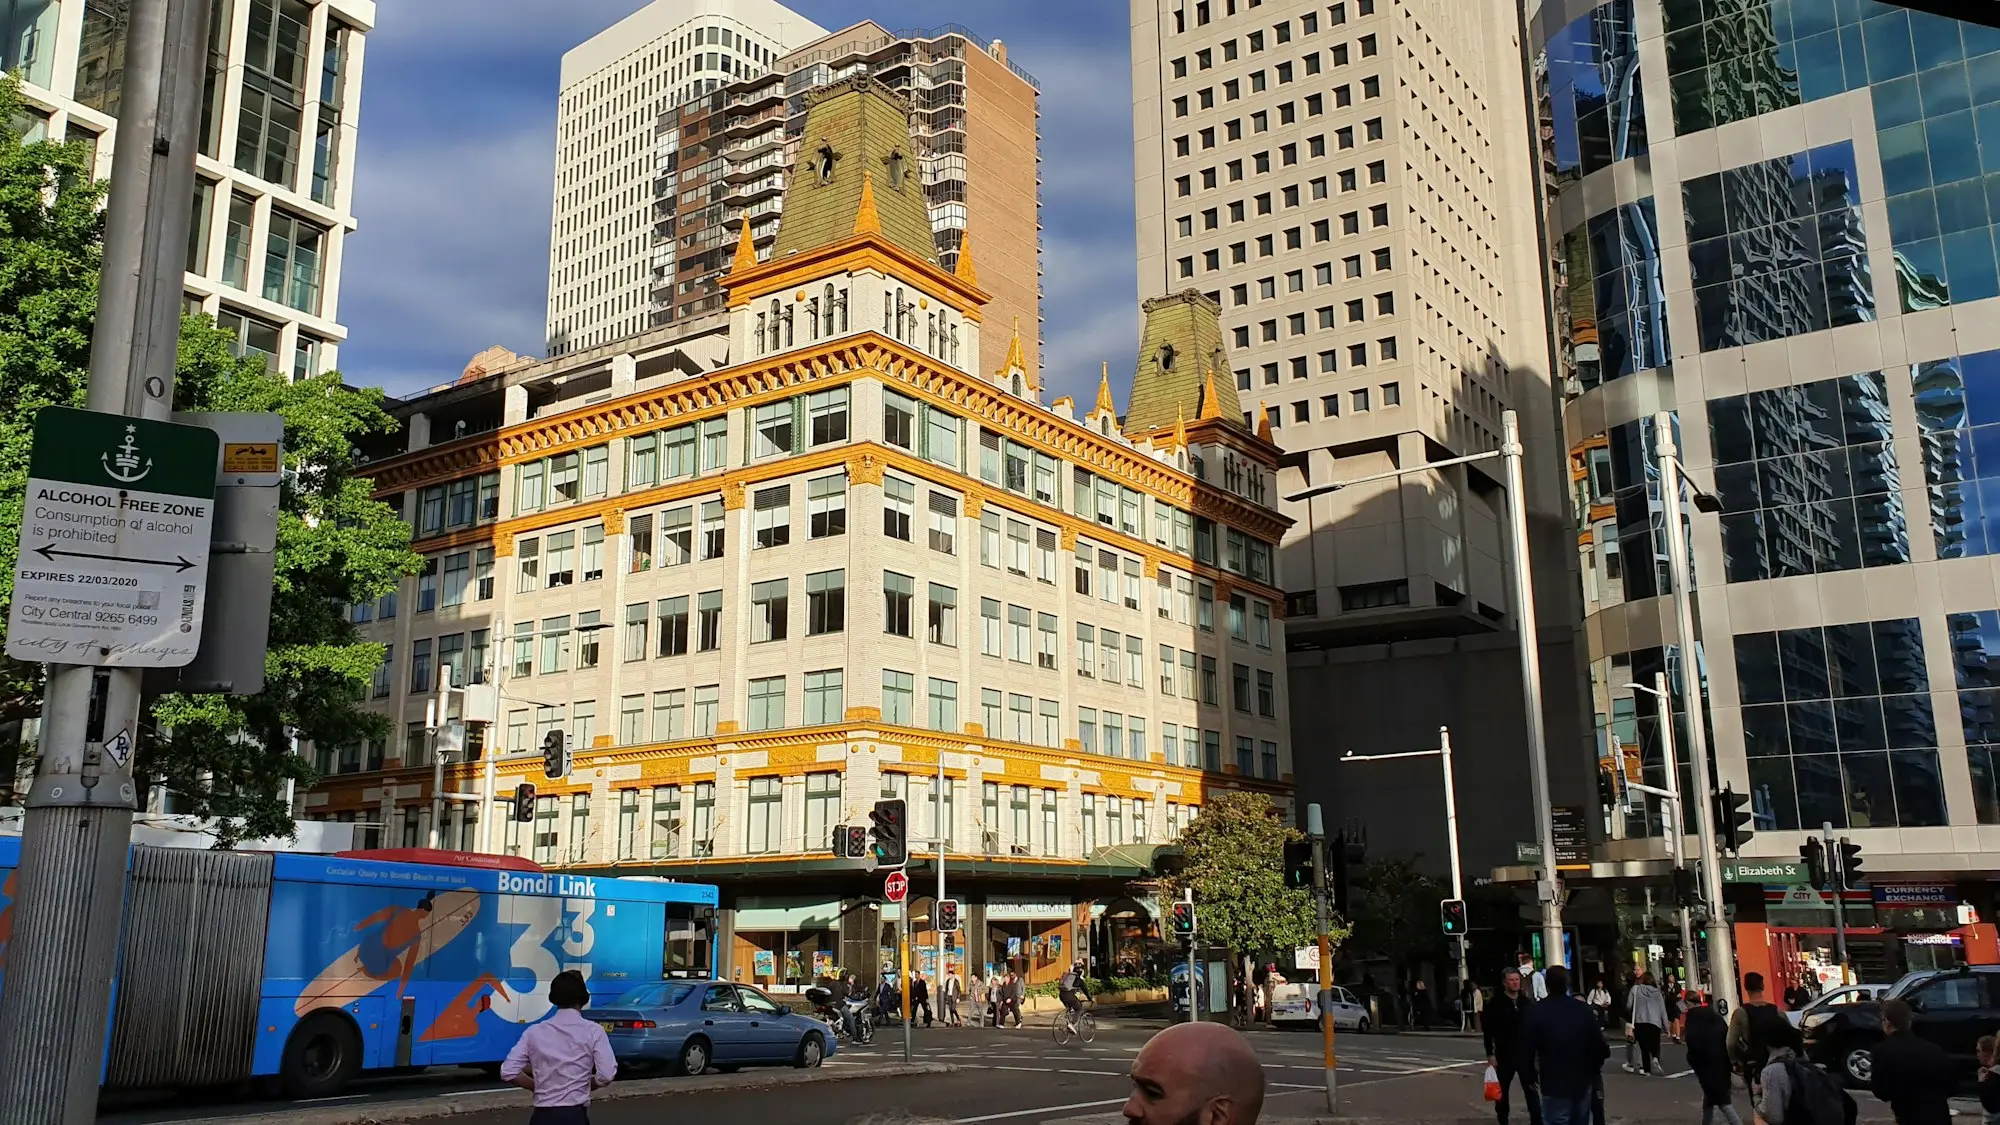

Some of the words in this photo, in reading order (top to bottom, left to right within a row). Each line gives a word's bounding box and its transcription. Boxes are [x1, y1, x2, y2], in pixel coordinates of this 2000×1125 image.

[37, 488, 116, 508] ALCOHOL
[119, 498, 160, 513] FREE
[163, 503, 205, 518] ZONE
[35, 506, 126, 528] Consumption
[130, 519, 143, 530] of
[146, 521, 194, 535] alcohol
[32, 524, 44, 536] is
[48, 527, 117, 544] prohibited
[21, 570, 75, 582] EXPIRES
[78, 574, 138, 587] 22/03/2020
[21, 604, 46, 620] City
[49, 607, 92, 621] Central
[95, 611, 125, 624] 9265
[128, 614, 158, 626] 6499
[1739, 866, 1784, 876] Elizabeth
[1785, 865, 1797, 875] St
[498, 872, 554, 894] Bondi
[559, 875, 597, 897] Link
[887, 880, 906, 893] STOP
[1793, 892, 1811, 900] CITY
[991, 900, 1032, 912] DOWNING
[1036, 900, 1066, 912] CENTRE
